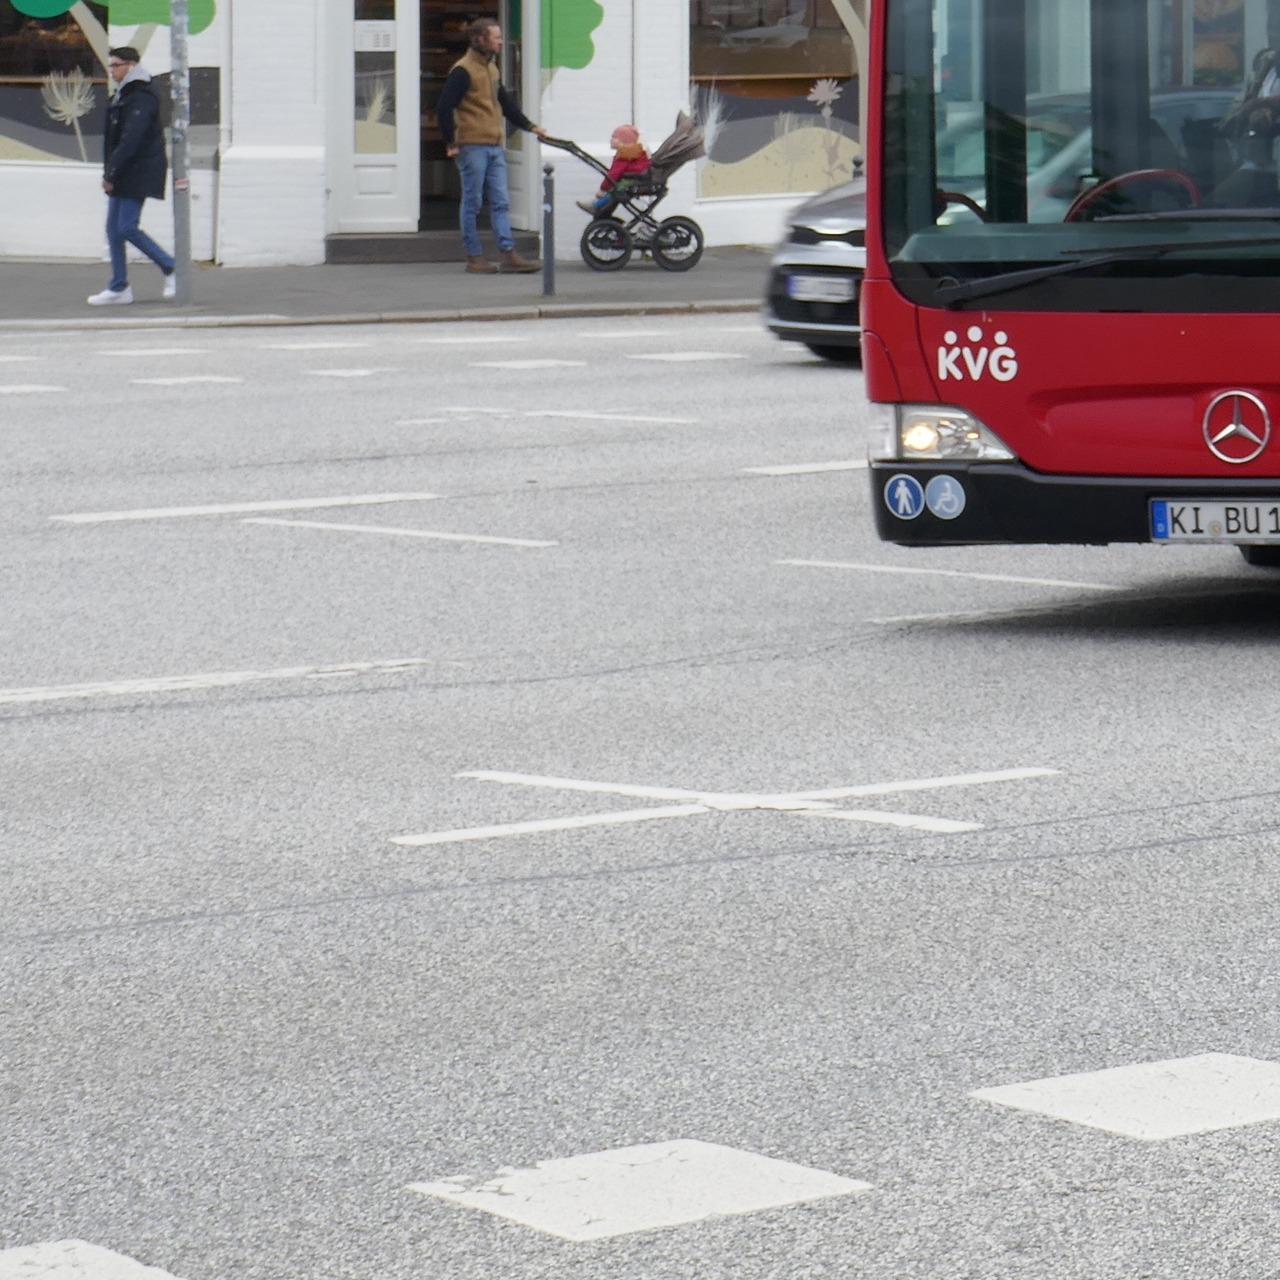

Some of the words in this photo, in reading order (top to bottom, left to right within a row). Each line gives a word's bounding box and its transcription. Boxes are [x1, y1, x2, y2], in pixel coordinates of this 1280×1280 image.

[938, 346, 1018, 382] KVG
[1170, 507, 1204, 534] KI
[1225, 507, 1260, 534] BU
